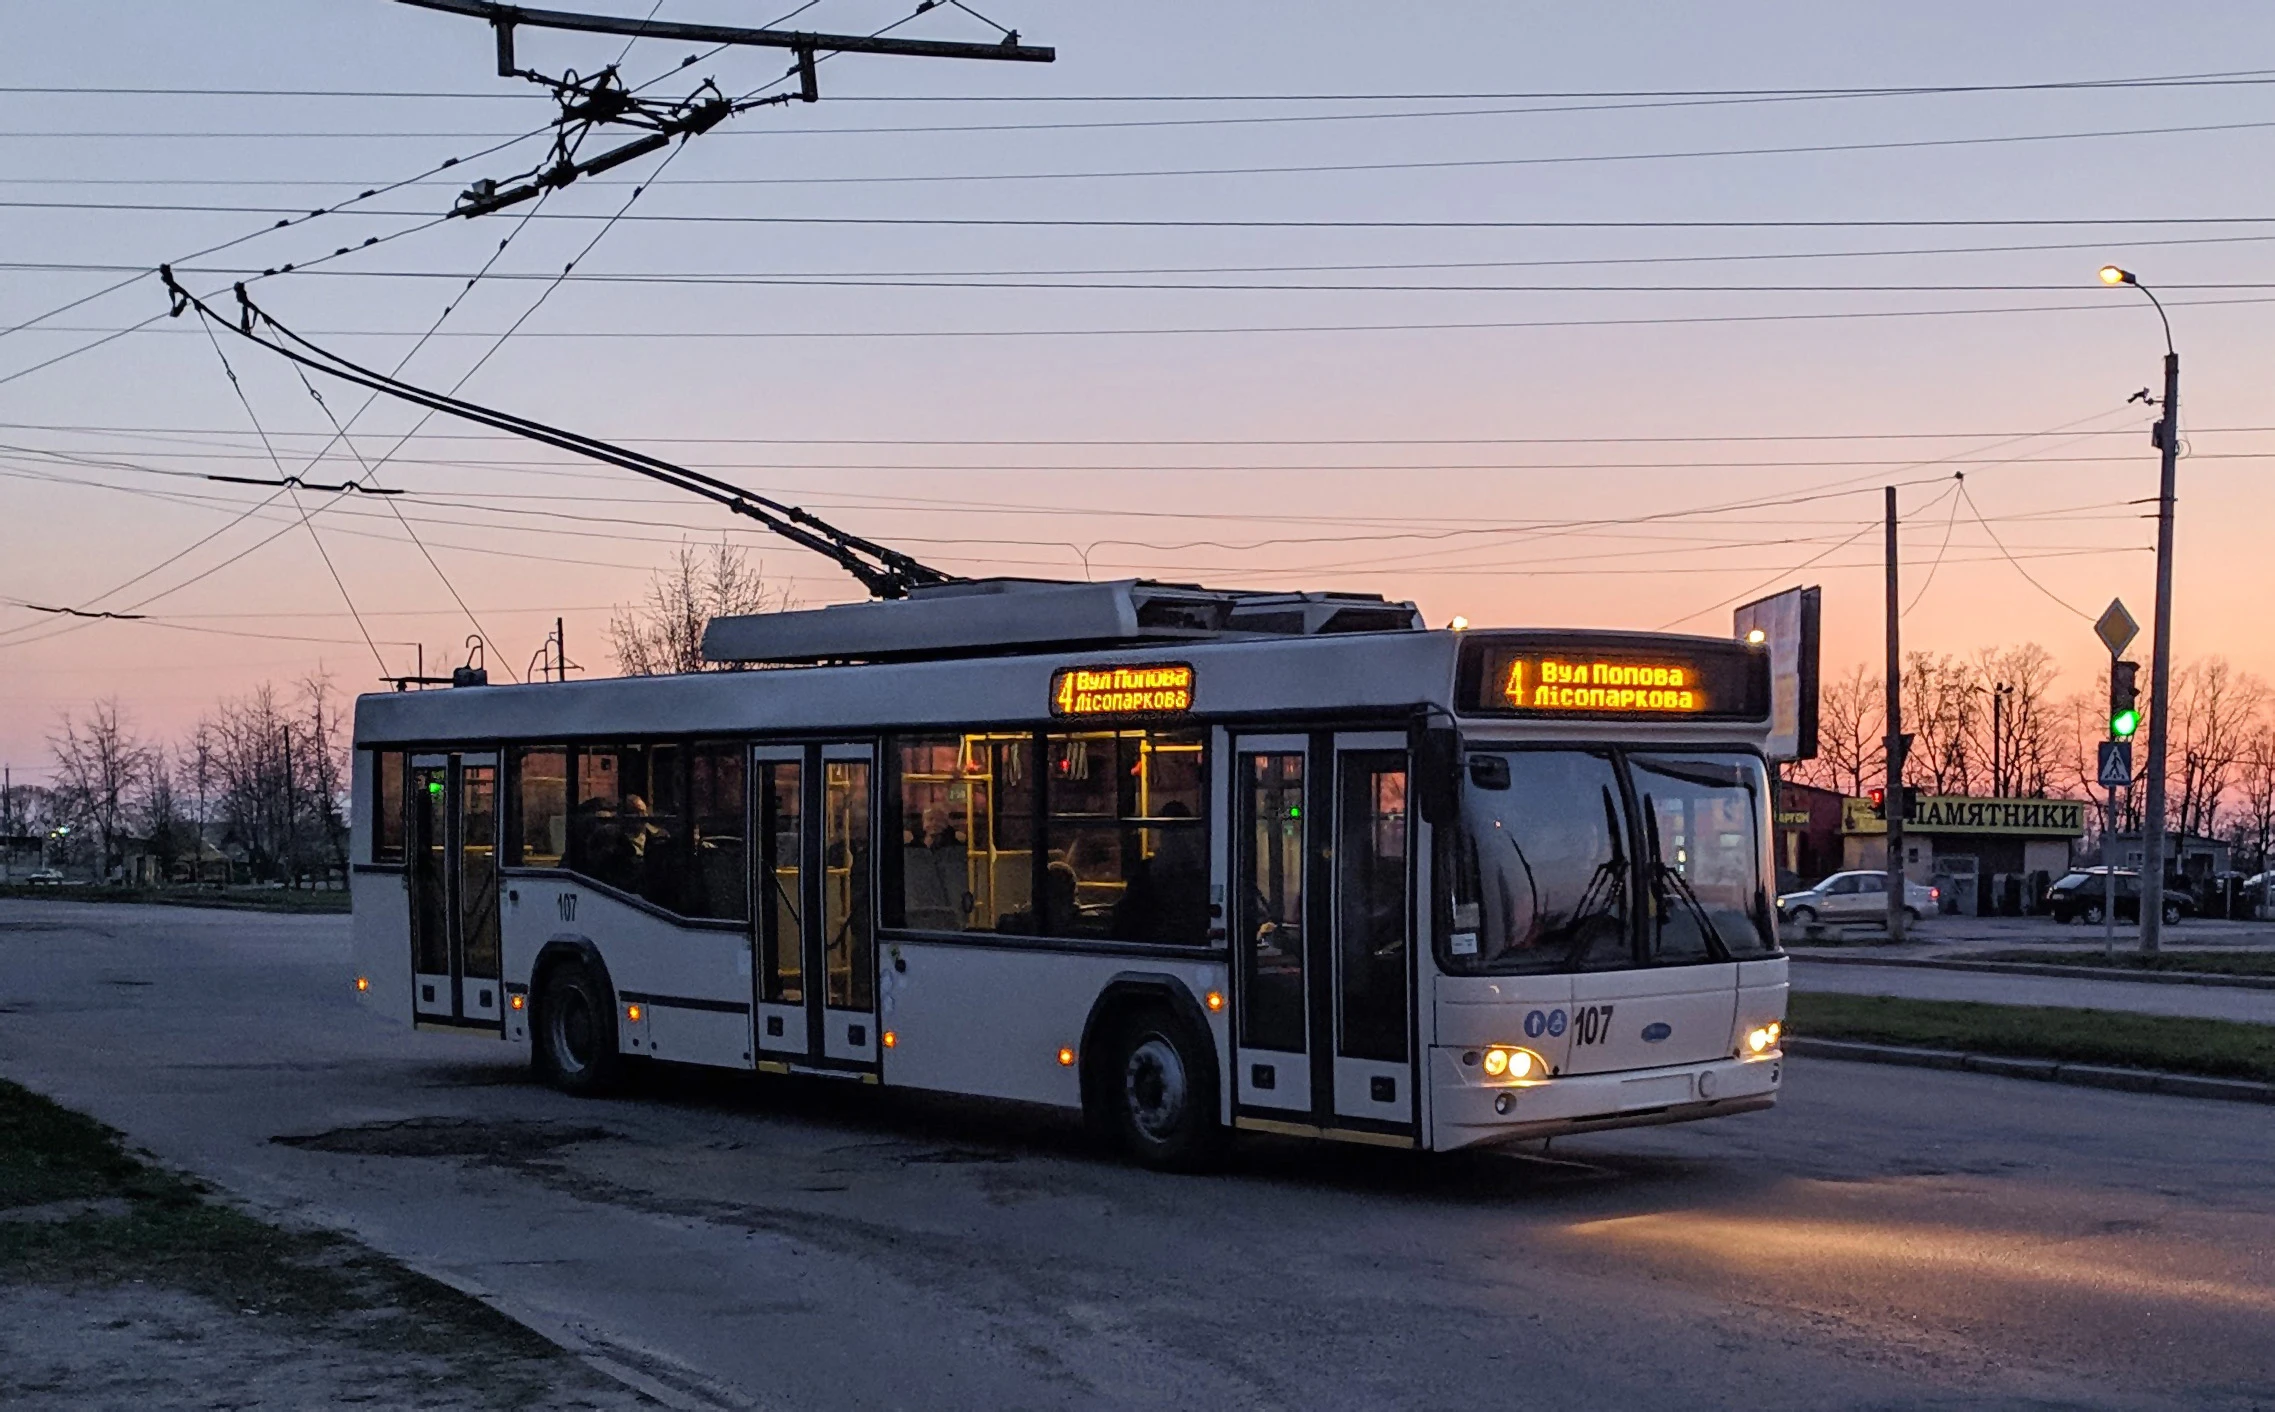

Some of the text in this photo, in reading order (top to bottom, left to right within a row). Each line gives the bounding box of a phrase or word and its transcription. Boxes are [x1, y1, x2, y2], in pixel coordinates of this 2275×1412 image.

[1077, 669, 1188, 690] Вул Попова
[1506, 660, 1523, 704] 4
[1541, 662, 1683, 686] Вул Попова
[1058, 671, 1073, 712] 4
[1075, 691, 1188, 712] Лісопаркова
[1534, 686, 1693, 708] Лісопаркова
[557, 893, 577, 921] 107
[1575, 1005, 1613, 1046] 107
